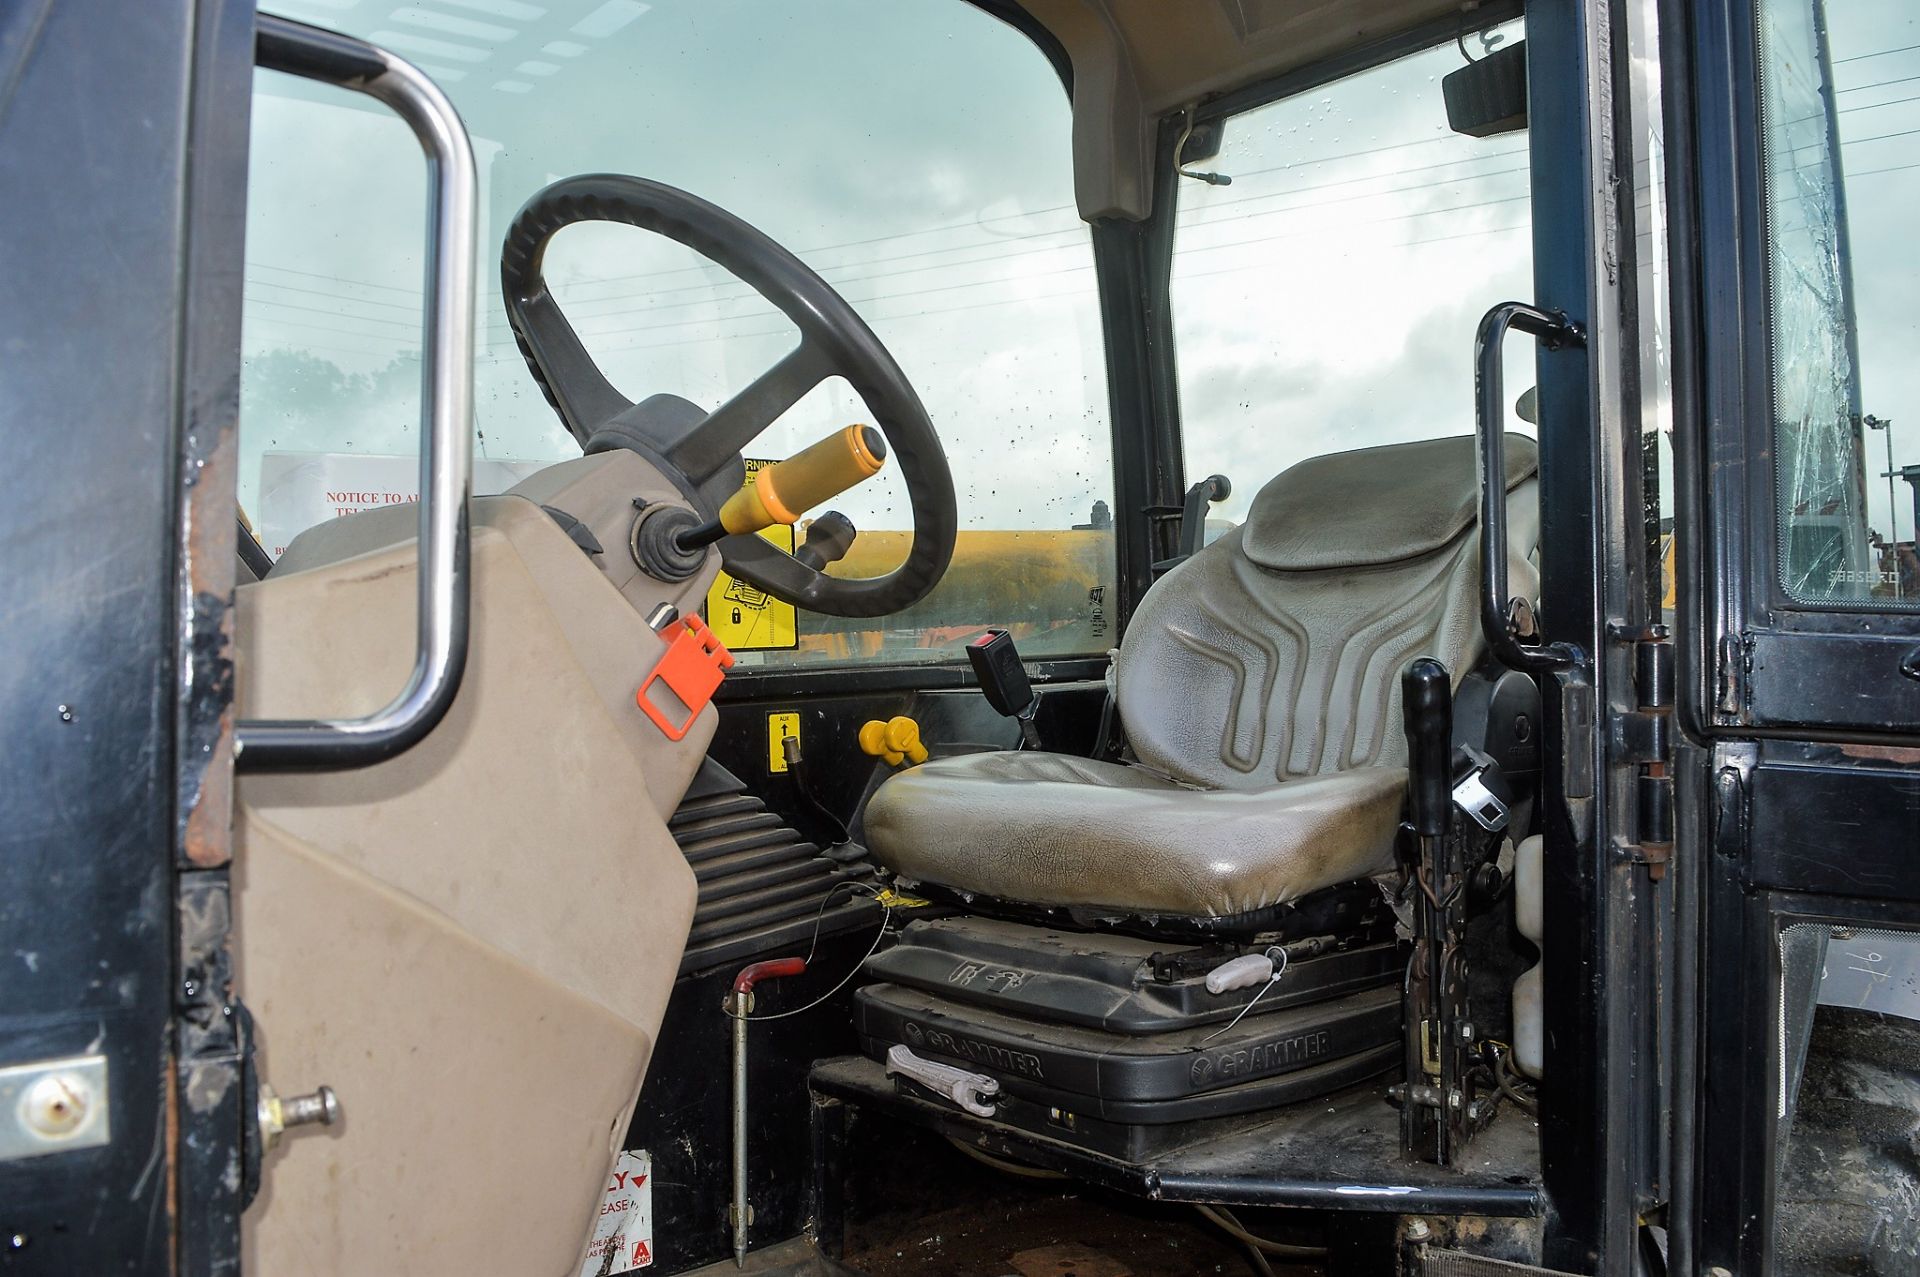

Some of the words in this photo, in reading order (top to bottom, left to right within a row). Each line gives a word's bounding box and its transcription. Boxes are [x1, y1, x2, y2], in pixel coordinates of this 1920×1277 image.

[326, 492, 379, 503] NOTICE
[382, 493, 402, 504] TO
[925, 1029, 1045, 1079] GRAMMER
[1218, 1031, 1329, 1076] GRAMMER
